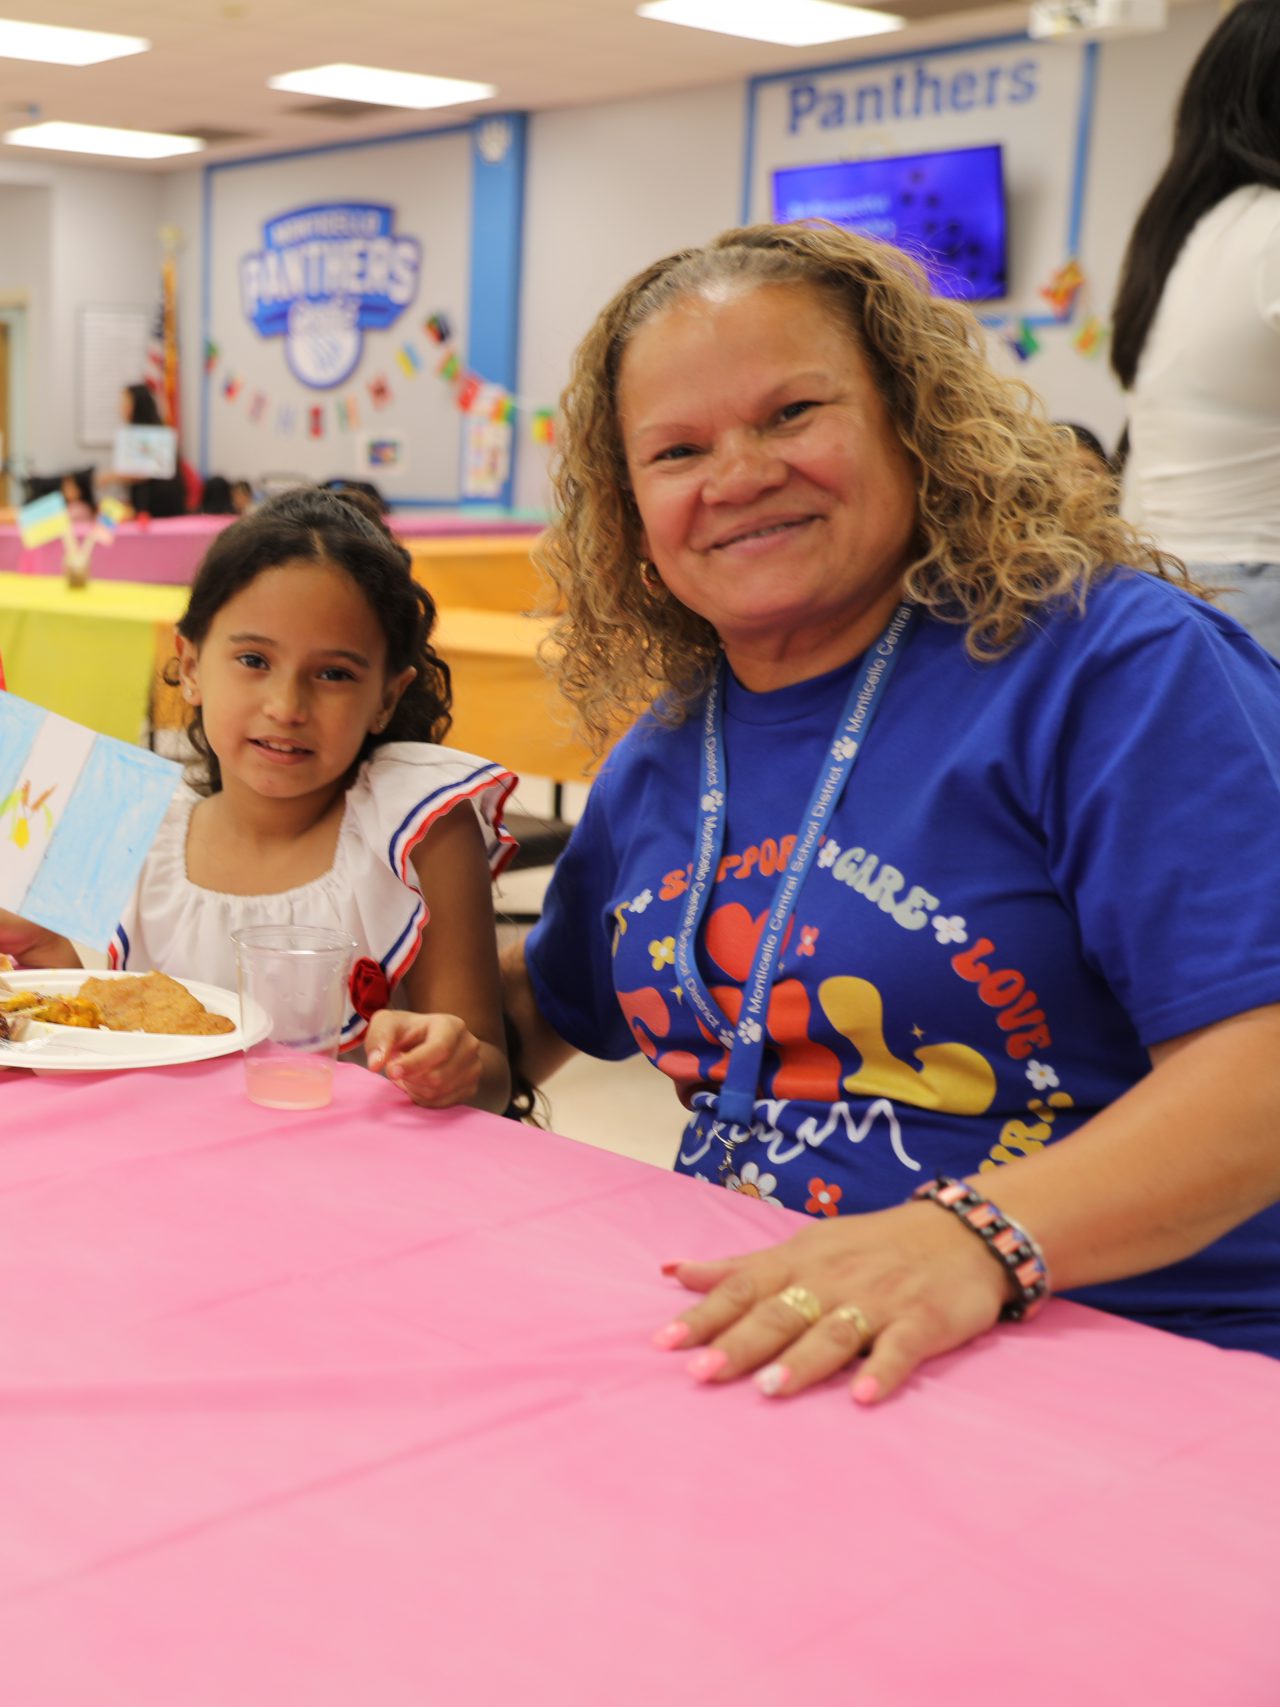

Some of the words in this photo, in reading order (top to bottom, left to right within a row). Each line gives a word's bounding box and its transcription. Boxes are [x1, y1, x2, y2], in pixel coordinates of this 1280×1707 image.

[787, 60, 1039, 136] Panthers
[243, 236, 418, 307] PANTHERS
[845, 657, 888, 733] Monticello
[876, 606, 913, 656] Central
[695, 815, 718, 881] Monticello
[747, 933, 778, 1014] Monticello
[769, 876, 799, 931] Central
[790, 820, 820, 872] School
[811, 766, 845, 818] District
[658, 834, 827, 901] SPPOR
[832, 846, 940, 931] CARE
[951, 937, 1052, 1060] LOVE
[684, 977, 720, 1029] District
